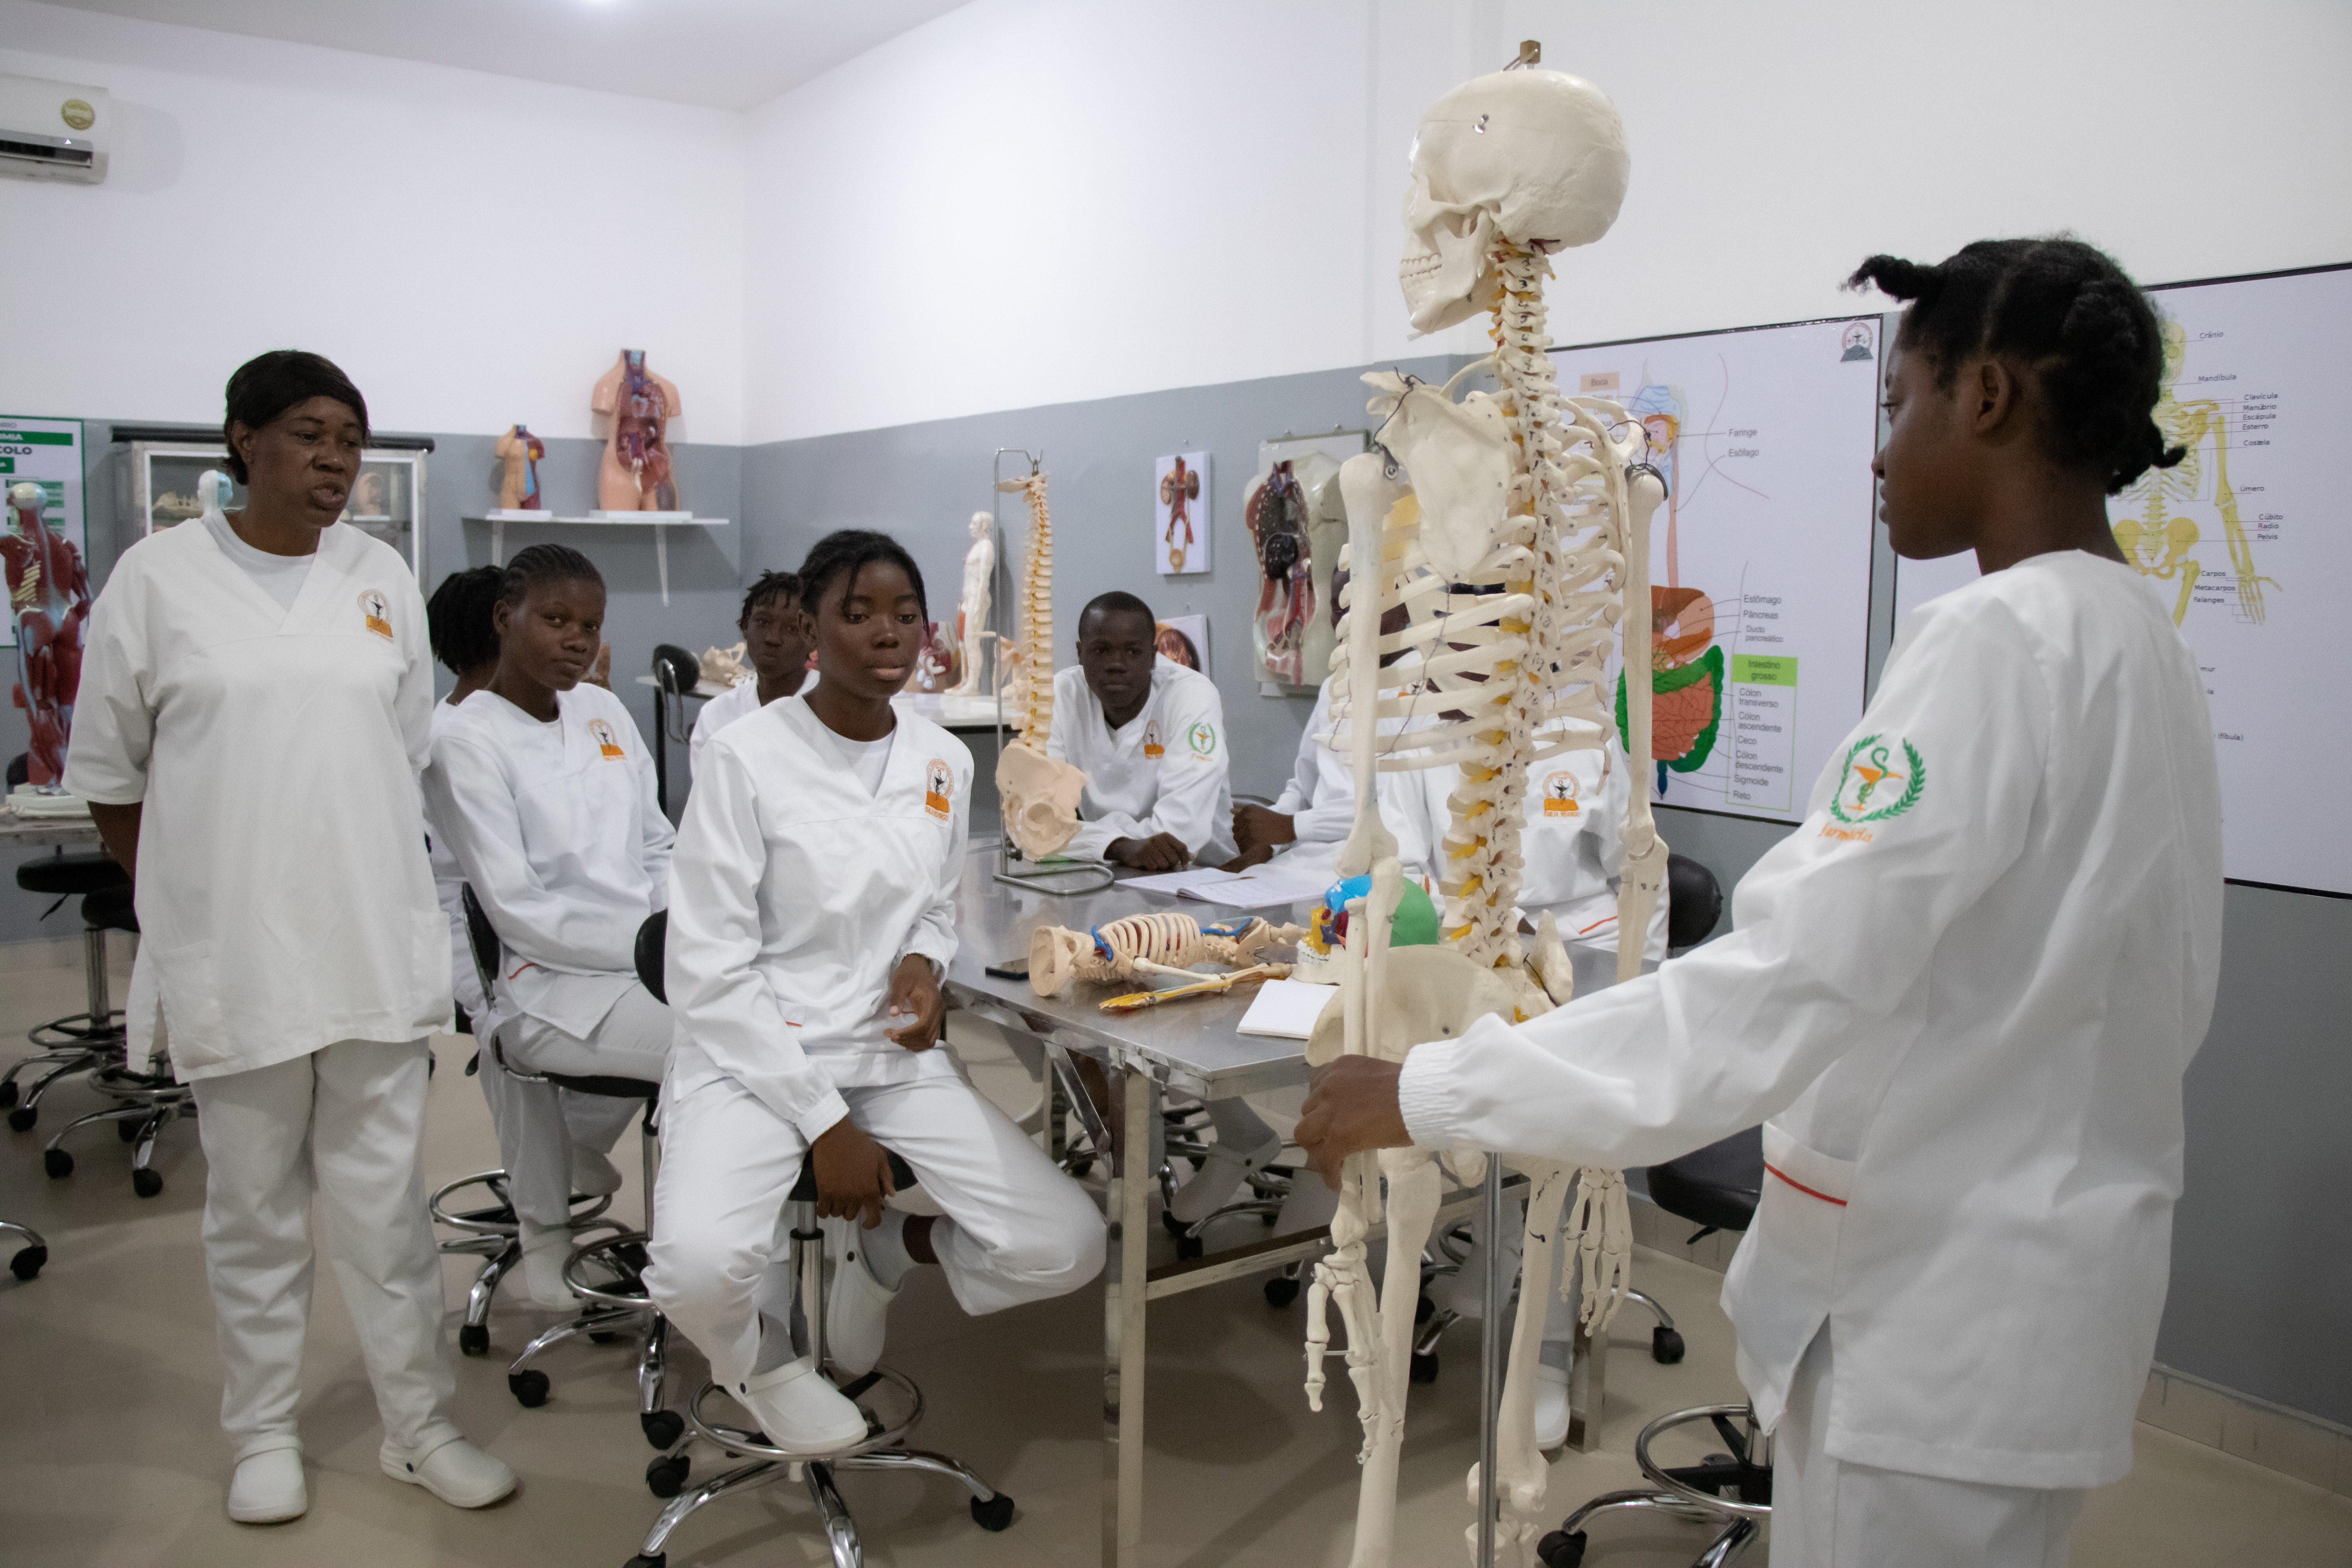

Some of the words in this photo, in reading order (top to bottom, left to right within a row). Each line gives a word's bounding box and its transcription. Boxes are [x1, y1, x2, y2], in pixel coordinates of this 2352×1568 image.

[2198, 374, 2236, 382] Mandíbula
[1729, 428, 1757, 438] Faringe
[1744, 594, 1782, 606] Estômago
[1743, 610, 1779, 619] Pâncreas
[1748, 660, 1780, 669] Intestino
[1751, 673, 1777, 681] grosso
[1740, 688, 1761, 697] Cólon
[1739, 698, 1779, 708] transverso
[1739, 723, 1782, 733] ascendente
[1738, 735, 1757, 745] Ceco
[1735, 761, 1784, 773] descendente
[1733, 790, 1751, 800] Reto
